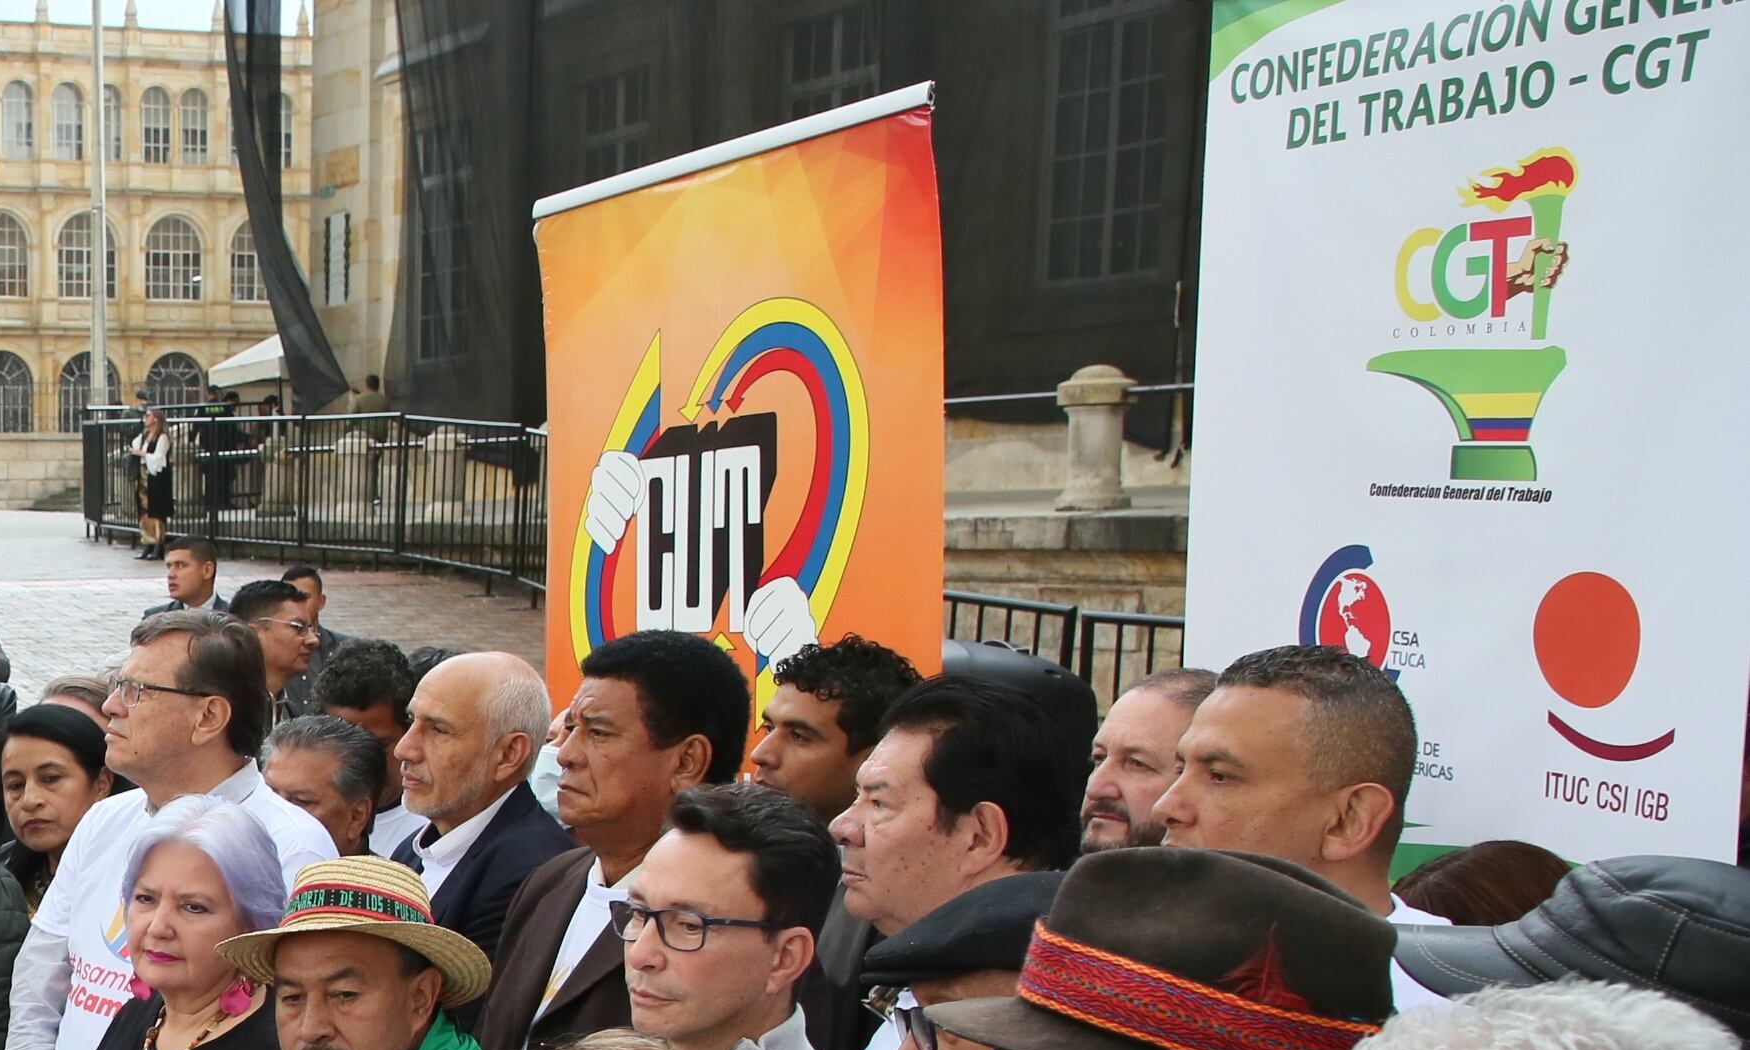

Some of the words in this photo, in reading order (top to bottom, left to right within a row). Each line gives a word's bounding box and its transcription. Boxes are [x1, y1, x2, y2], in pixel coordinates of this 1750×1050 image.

[1230, 0, 1551, 104] CONFEDERACIÓN
[1286, 104, 1346, 150] DEL
[1358, 60, 1554, 136] TRABAJO
[1602, 28, 1711, 95] CGT
[1394, 216, 1532, 322] CGT
[1392, 320, 1527, 339] COLOMBIA
[1442, 485, 1484, 501] General
[1486, 487, 1506, 501] del
[1507, 487, 1552, 504] Trabajo
[637, 443, 762, 634] CUT
[1392, 630, 1419, 648] CSA
[1391, 650, 1426, 669] TUCA
[1423, 741, 1440, 758] DE
[1413, 761, 1454, 781] ERICAS
[1545, 771, 1590, 804] ITUC
[1596, 779, 1628, 814] CSI
[1635, 787, 1670, 822] IGB
[340, 890, 353, 908] DE
[367, 894, 383, 912] LOS
